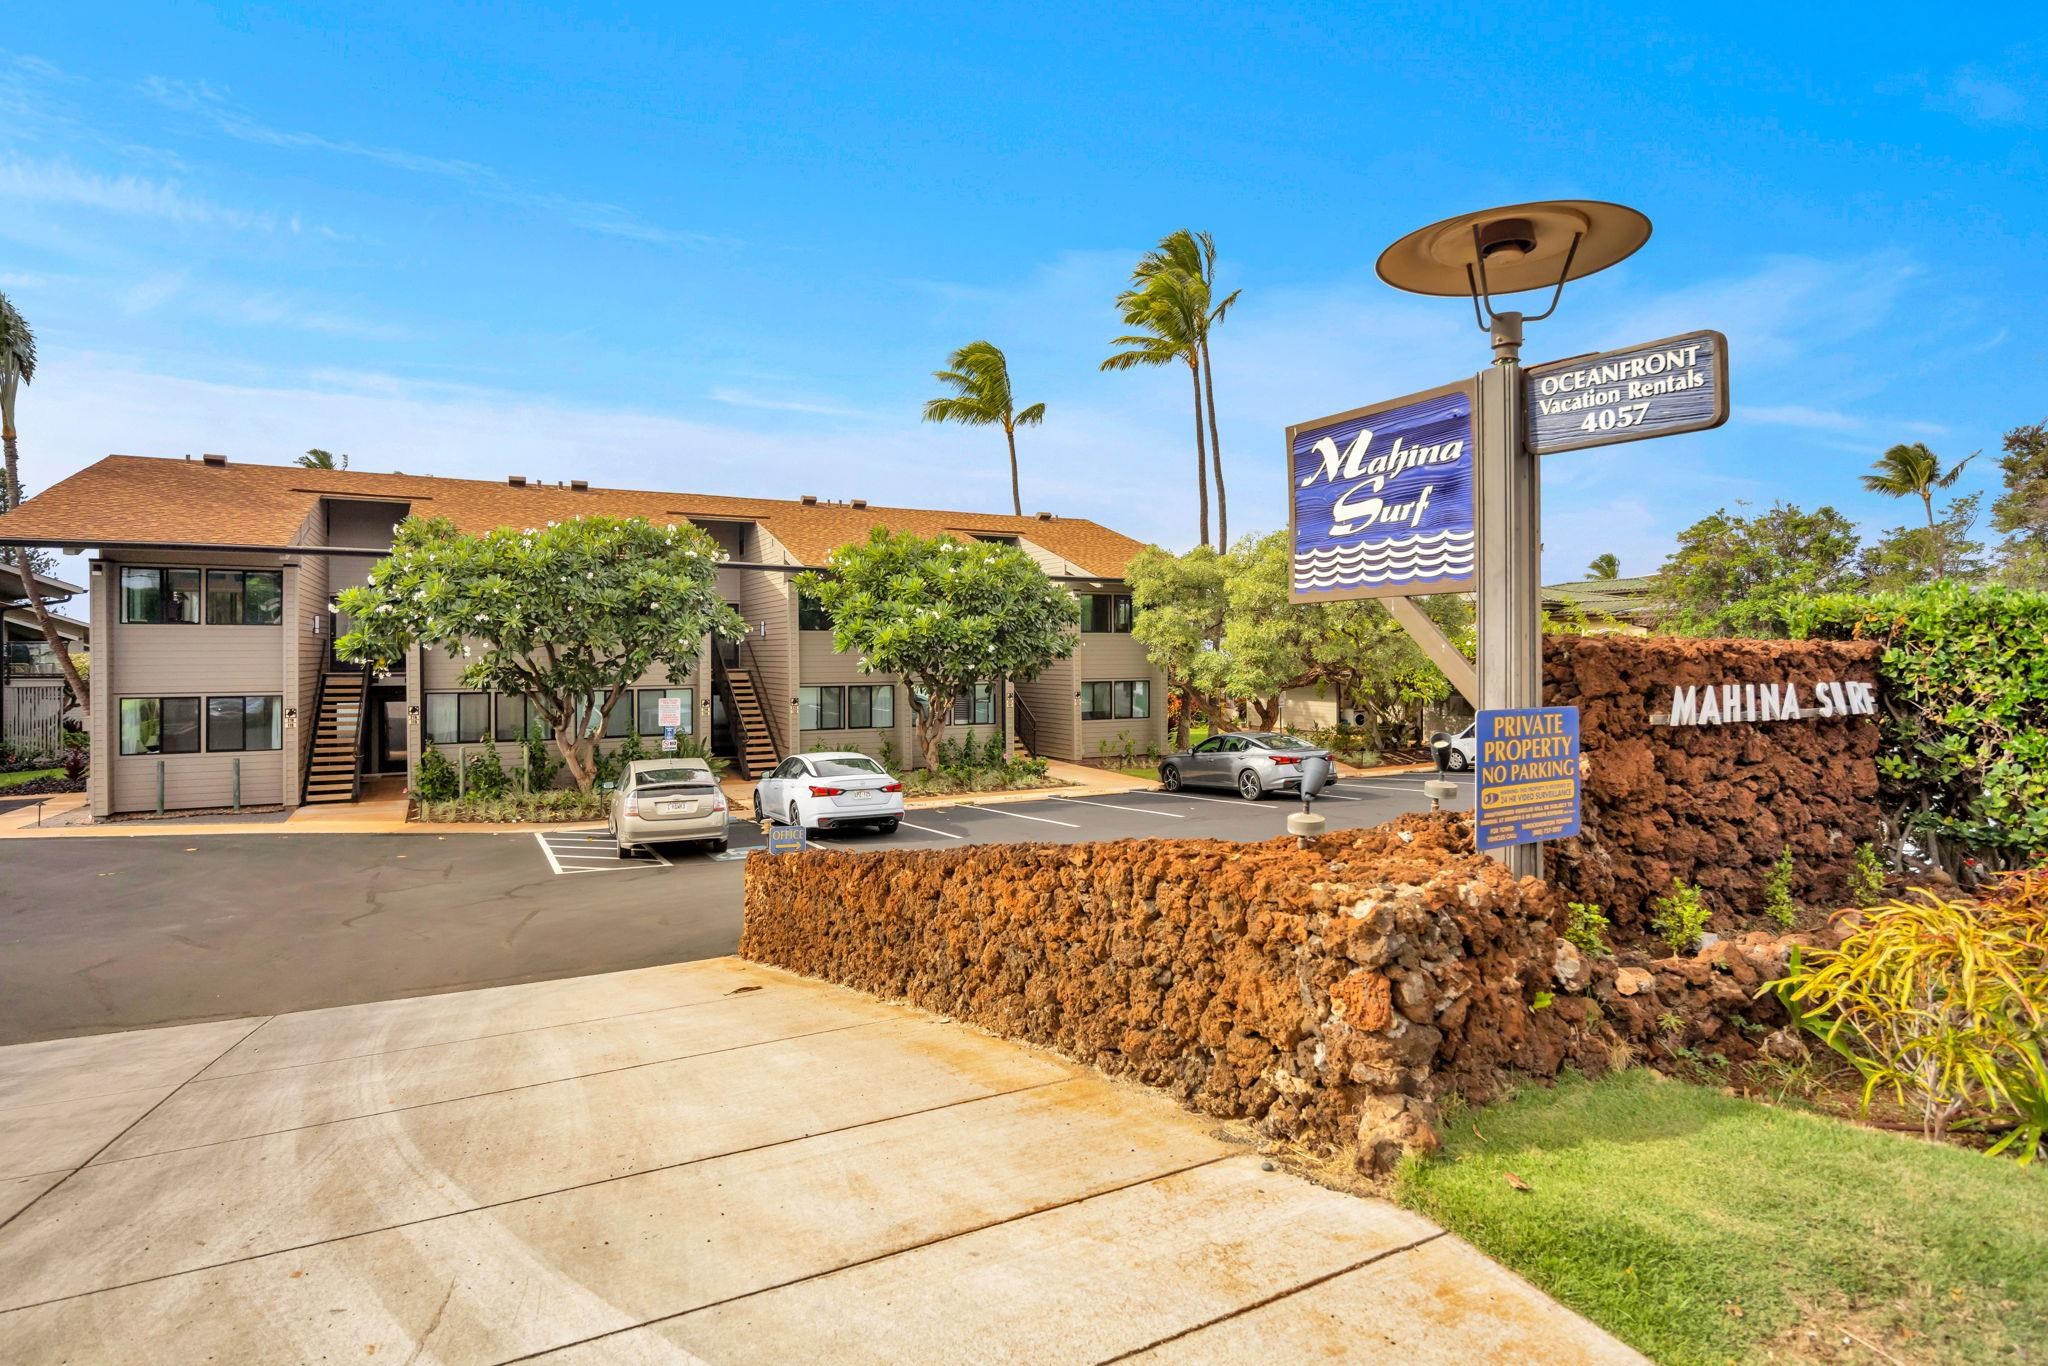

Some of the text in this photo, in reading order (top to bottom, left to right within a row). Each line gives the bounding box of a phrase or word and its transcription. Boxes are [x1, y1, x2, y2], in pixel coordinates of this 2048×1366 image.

[1540, 345, 1702, 396] OCEANFRONT
[1539, 370, 1705, 416] Vacation Rentals
[1580, 402, 1650, 433] 4057
[1301, 429, 1465, 488] Mahina
[1328, 476, 1435, 537] Surf
[1669, 682, 1801, 727] MAHINA
[1494, 713, 1564, 738] PRIVATE
[1484, 736, 1573, 763] PROPERTY
[1482, 759, 1575, 785] NO PARKING
[1518, 792, 1535, 801] VIDEO
[1535, 788, 1572, 800] SURVEILLANCE
[772, 829, 804, 841] OFFICE
